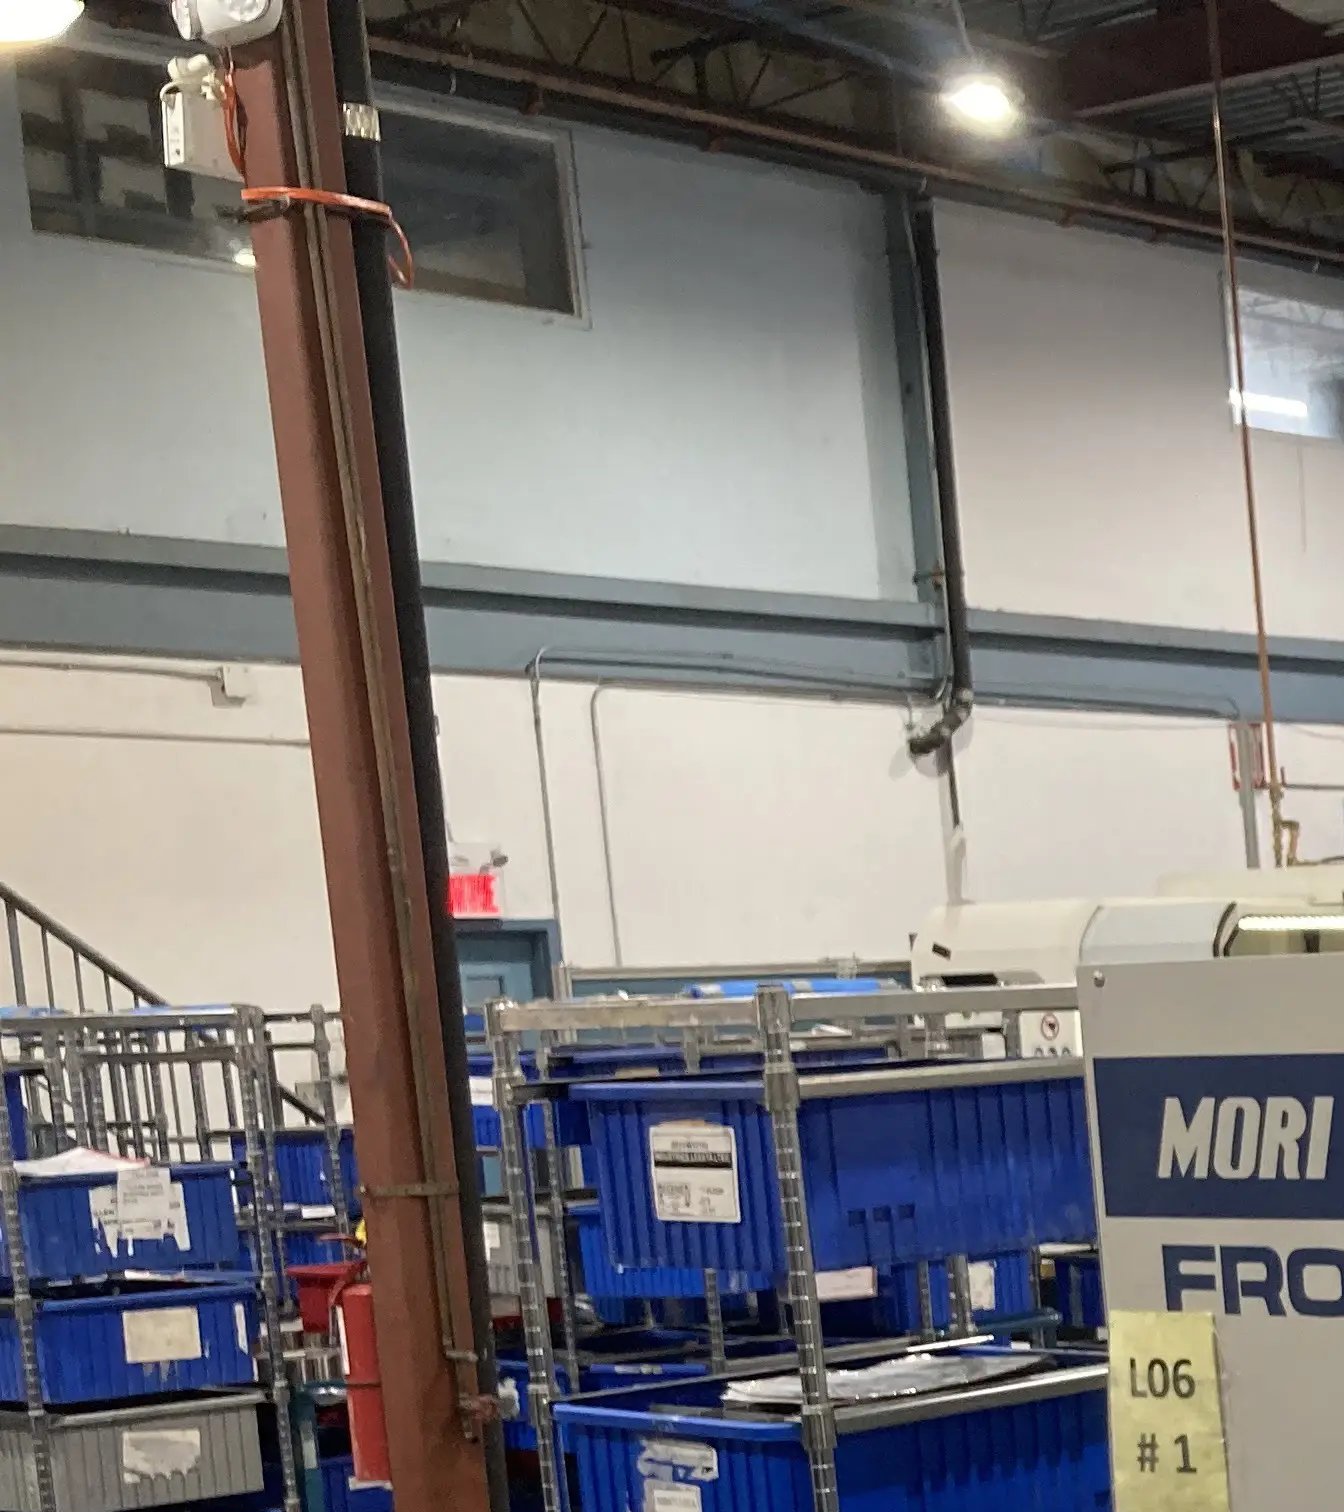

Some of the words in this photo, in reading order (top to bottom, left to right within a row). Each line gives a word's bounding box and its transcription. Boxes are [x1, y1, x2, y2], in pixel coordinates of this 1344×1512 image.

[1157, 1095, 1334, 1181] MORI
[1137, 1434, 1159, 1473] #
[1173, 1434, 1198, 1474] 1
